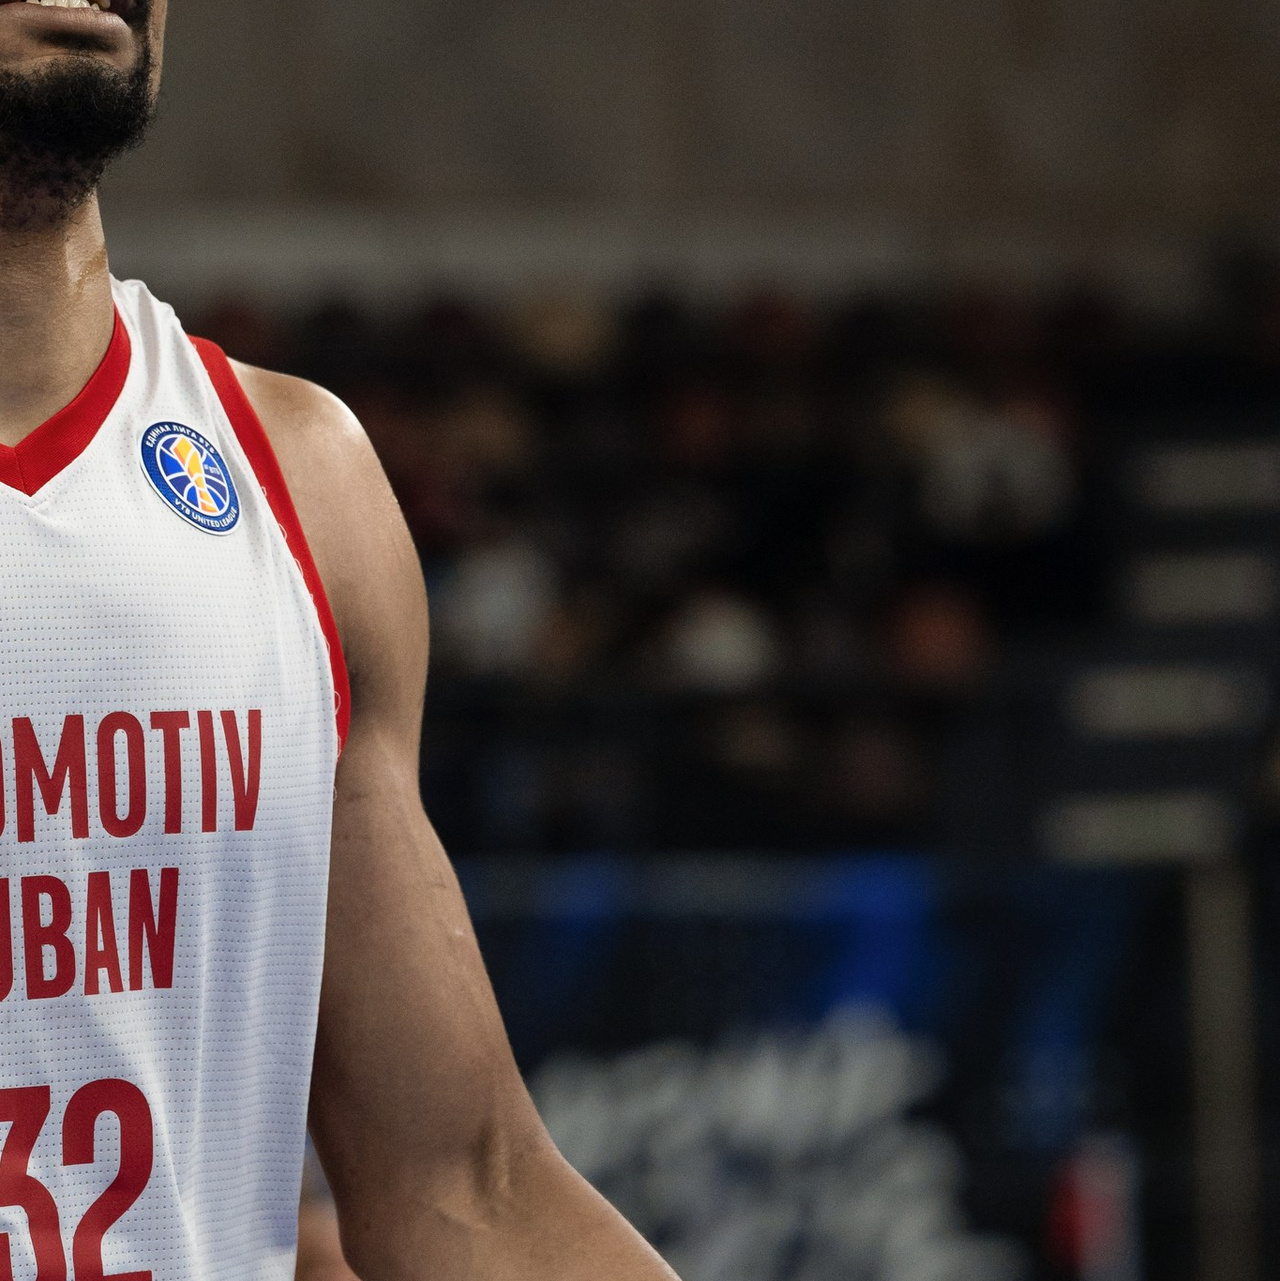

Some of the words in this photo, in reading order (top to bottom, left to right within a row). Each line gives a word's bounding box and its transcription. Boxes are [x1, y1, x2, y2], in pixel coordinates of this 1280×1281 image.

[172, 425, 197, 440] ЛИГА
[175, 498, 191, 515] VTB
[192, 512, 220, 528] UNITED
